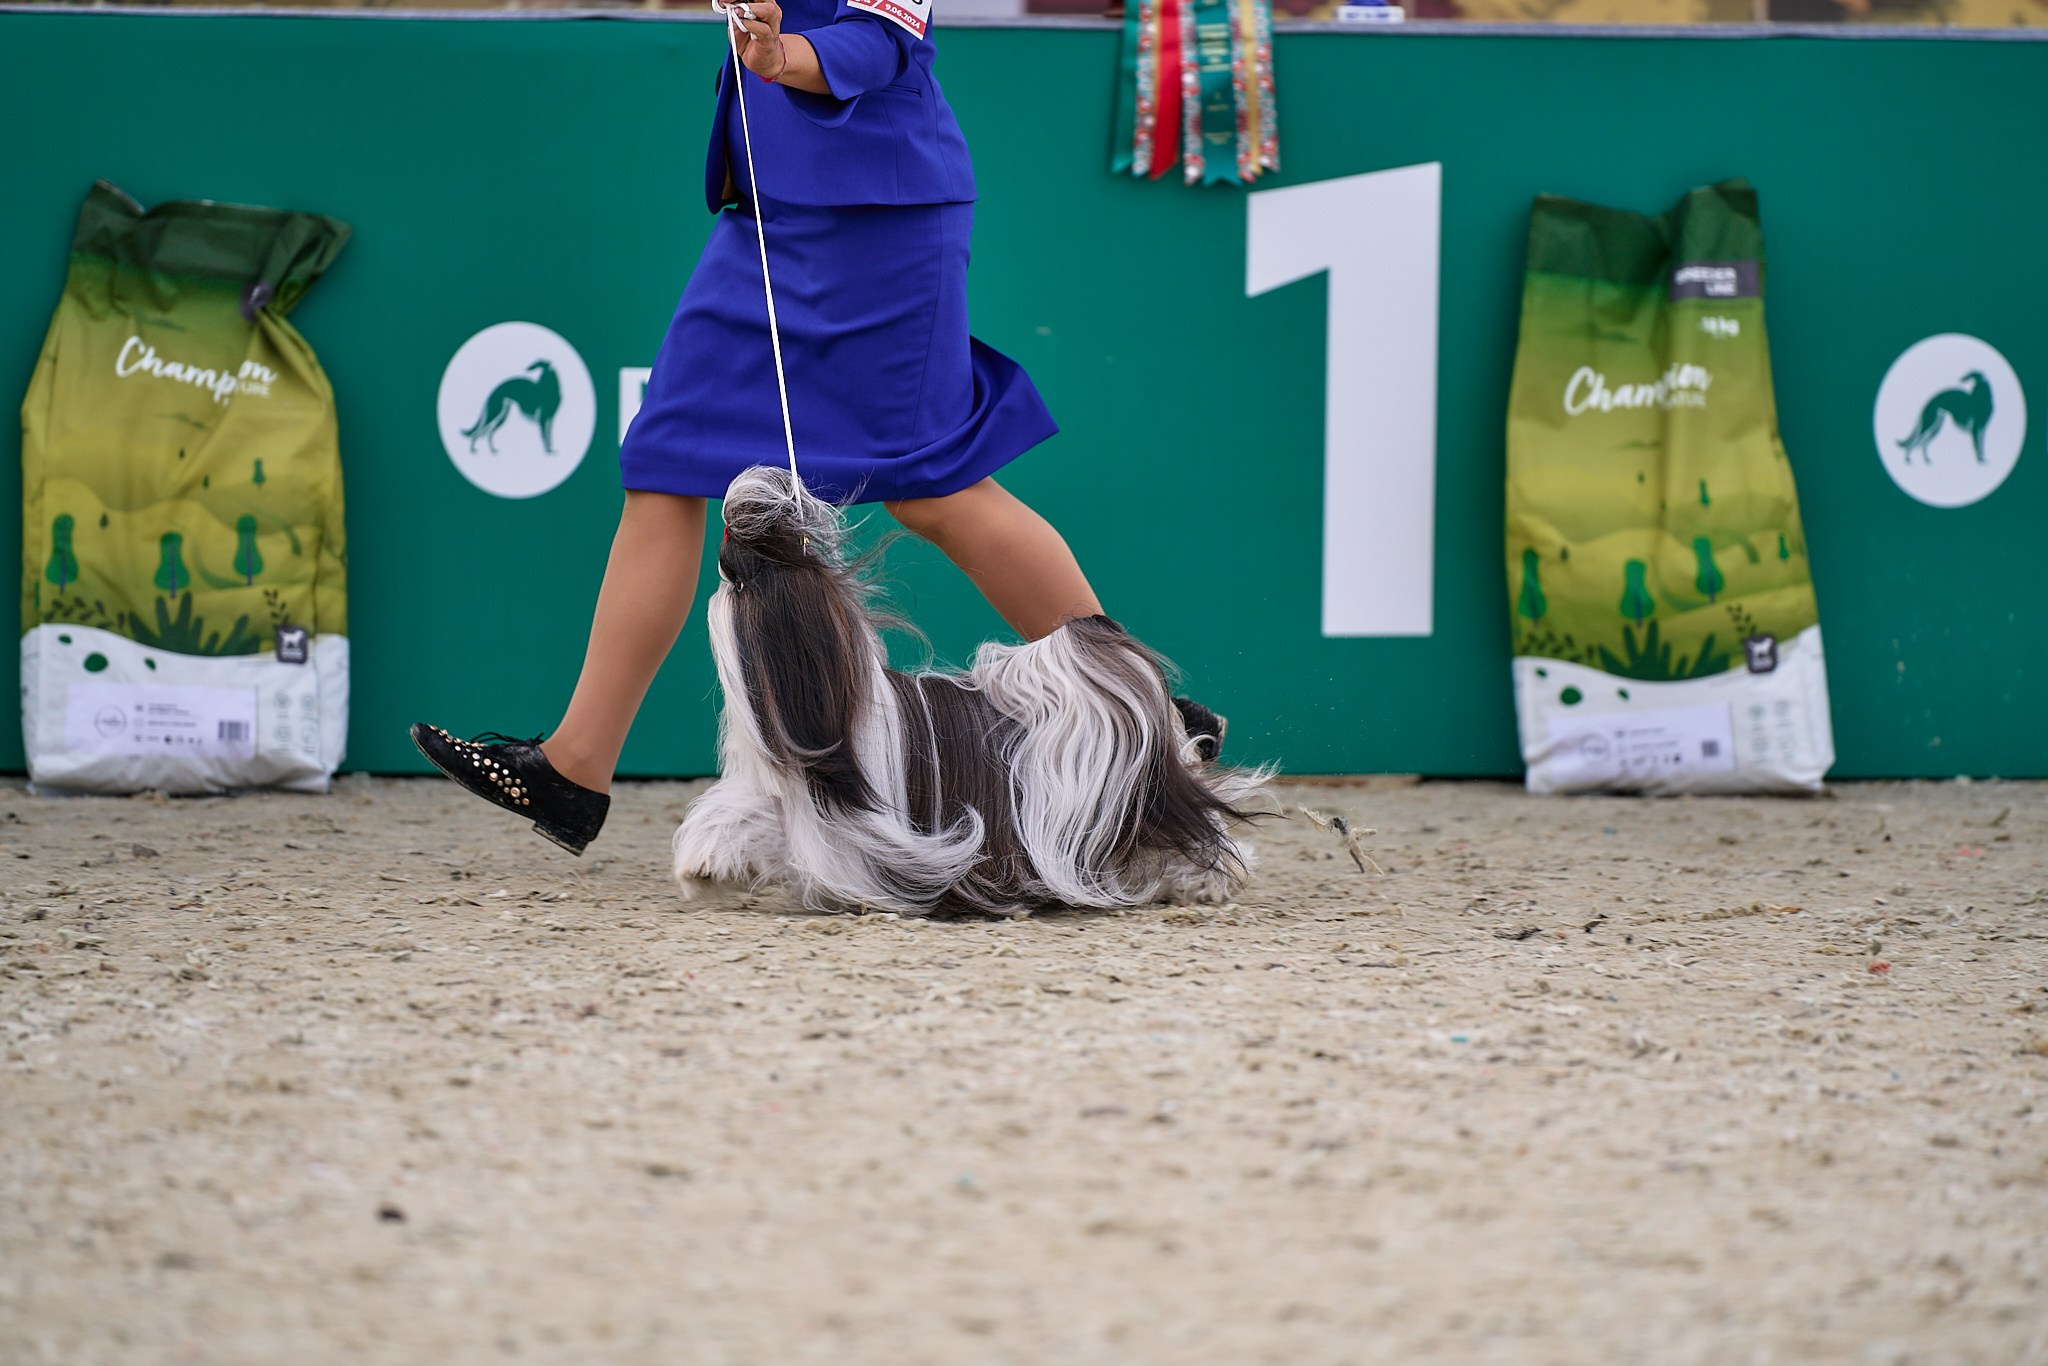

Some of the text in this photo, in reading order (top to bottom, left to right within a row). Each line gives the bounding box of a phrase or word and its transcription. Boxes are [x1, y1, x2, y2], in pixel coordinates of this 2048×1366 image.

[885, 3, 921, 28] 9.06.2024
[116, 335, 278, 404] Champon
[1247, 161, 1441, 637] 1
